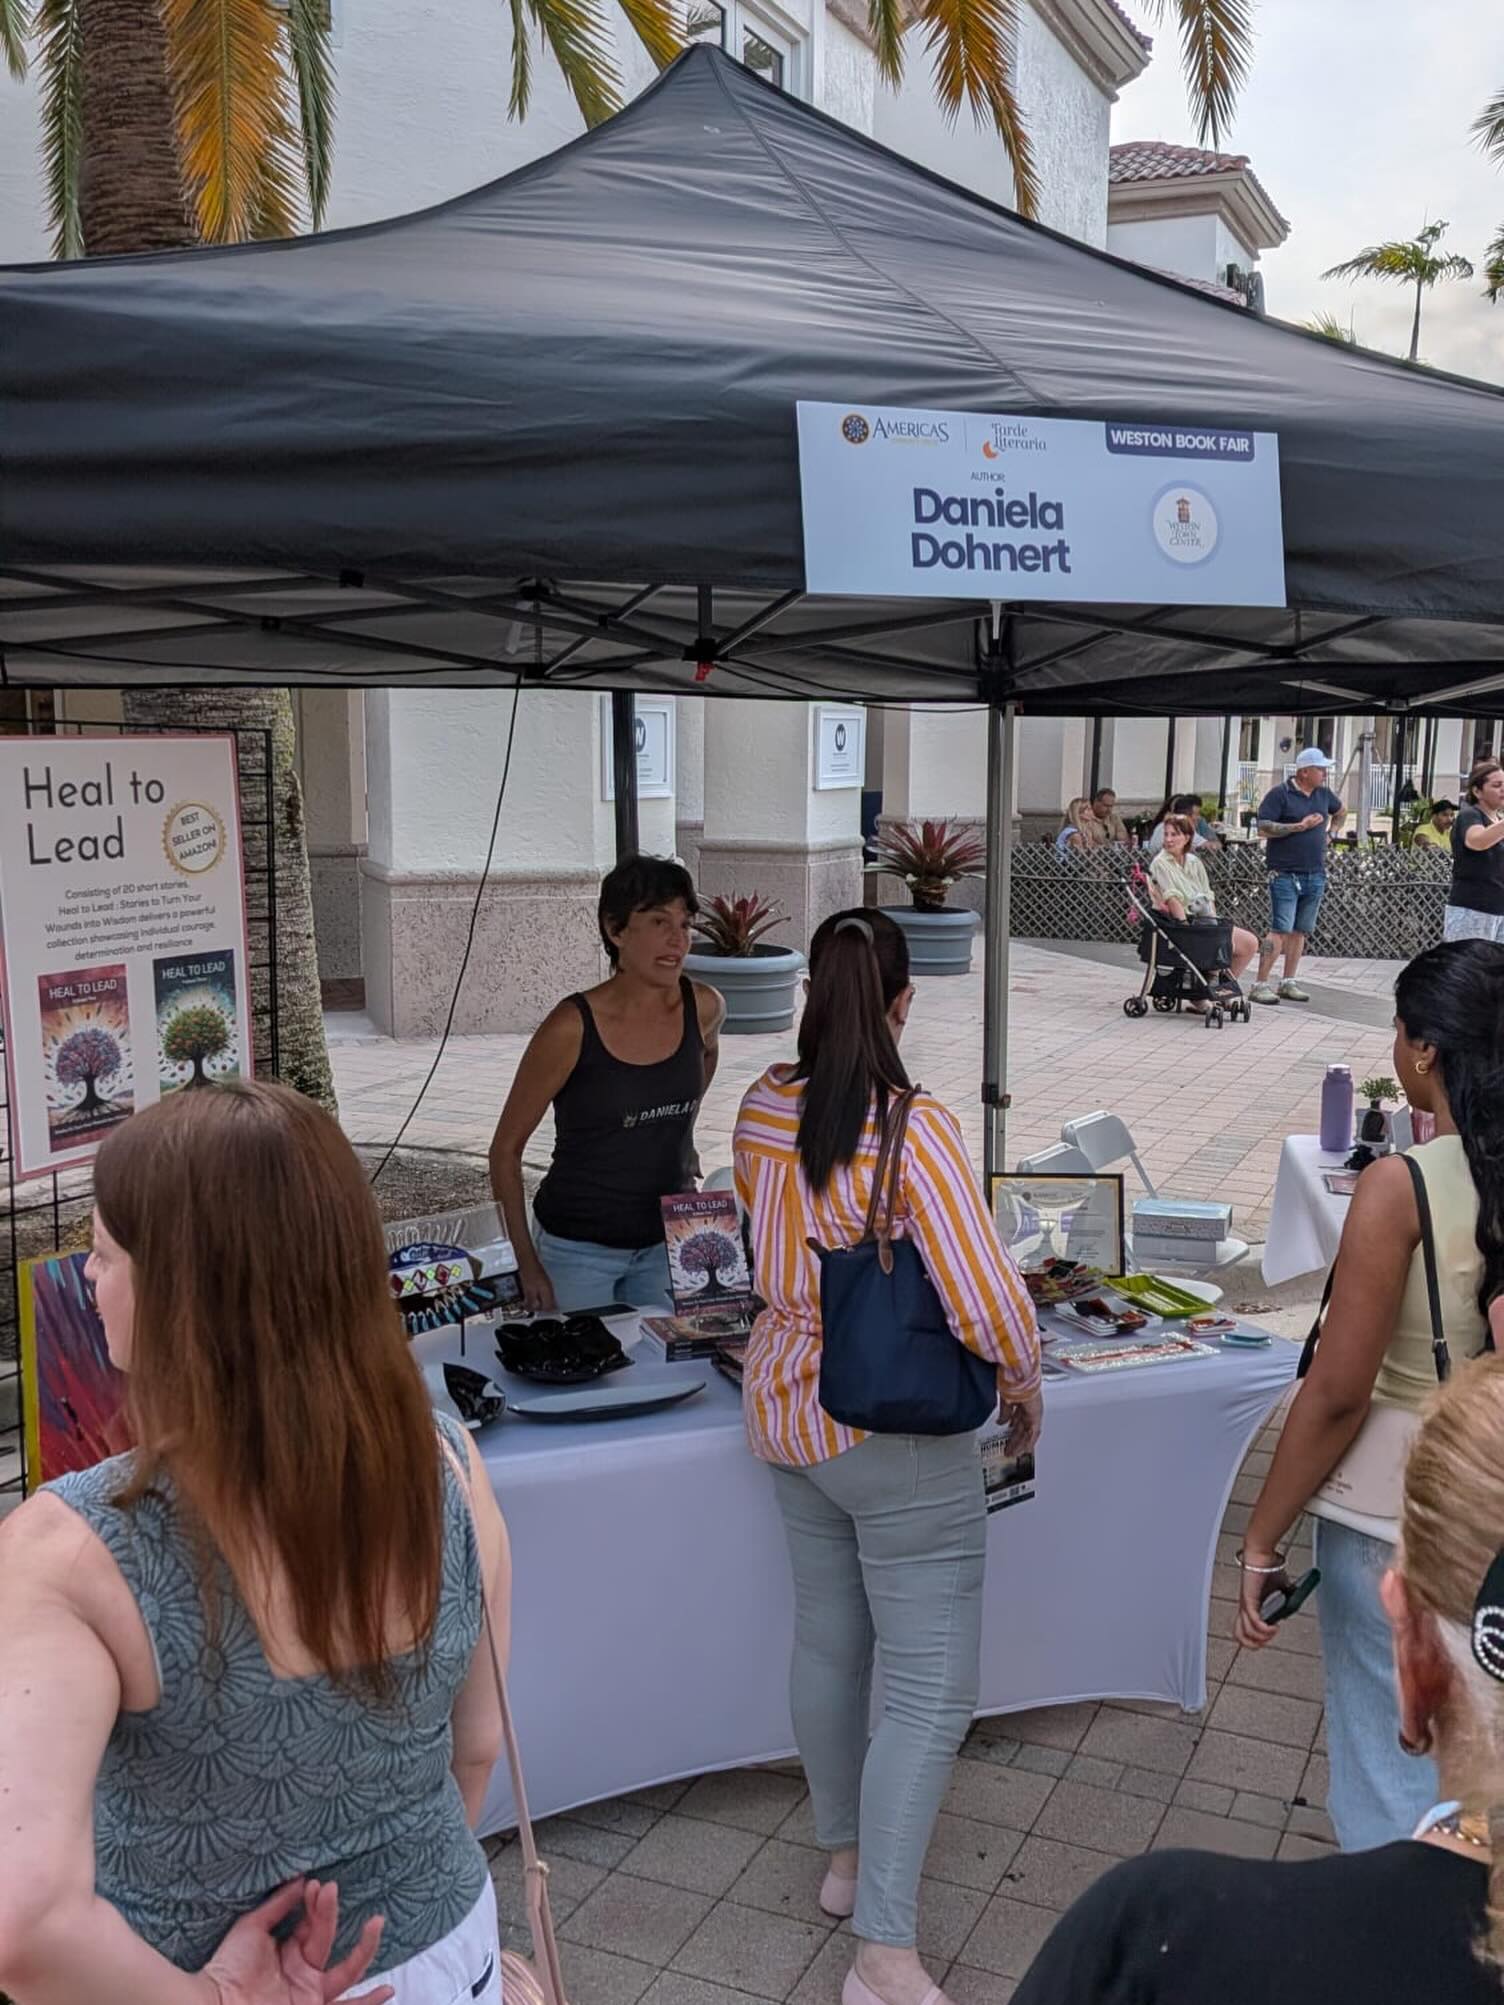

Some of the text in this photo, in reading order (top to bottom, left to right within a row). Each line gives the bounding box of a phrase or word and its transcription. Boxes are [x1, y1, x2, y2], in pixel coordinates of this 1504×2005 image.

[872, 417, 950, 442] AMERICAS
[991, 422, 1028, 437] Tarde
[1110, 429, 1250, 453] WESTON BOOK FAIR
[913, 487, 1064, 531] Daniela
[911, 532, 1072, 574] Dohnert
[23, 761, 164, 810] Heal to
[181, 811, 200, 826] BEST
[27, 815, 124, 865] Lead
[162, 967, 187, 980] HEAL
[188, 964, 200, 976] TO
[202, 961, 225, 974] LEAD
[49, 985, 76, 999] HEAL
[77, 983, 91, 994] TO
[92, 979, 117, 993] LEAD
[673, 1202, 695, 1212] HEAL
[696, 1201, 707, 1210] TO
